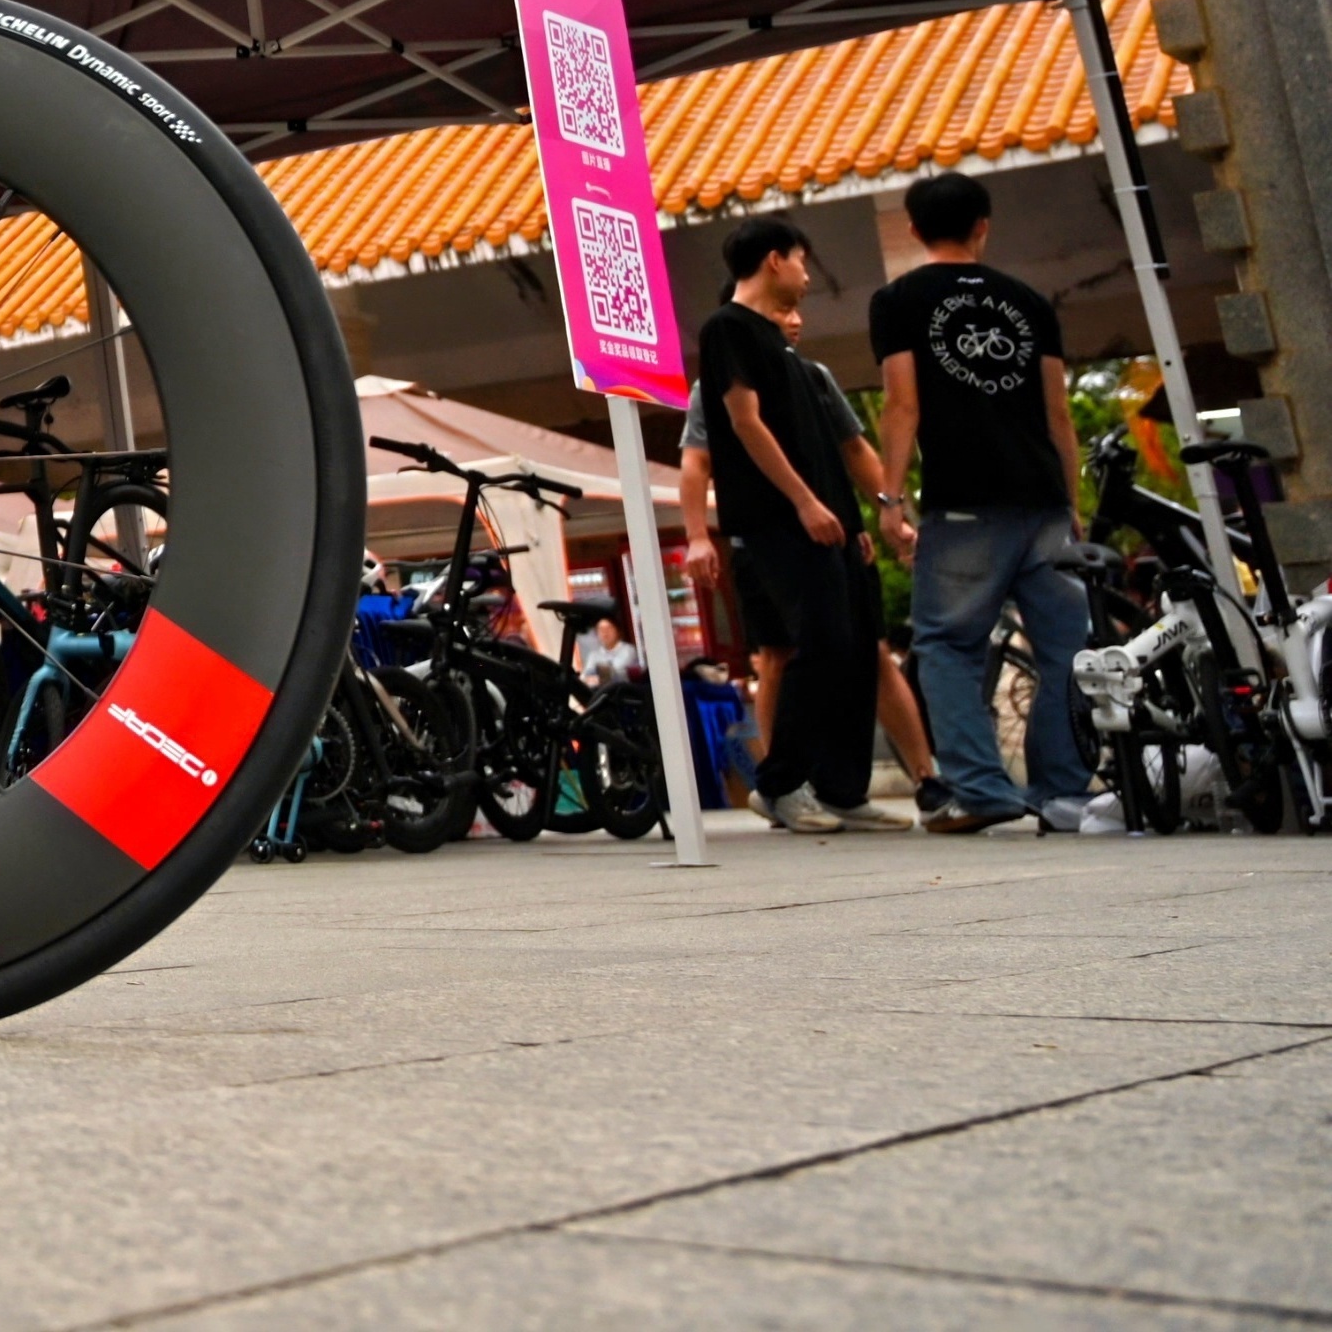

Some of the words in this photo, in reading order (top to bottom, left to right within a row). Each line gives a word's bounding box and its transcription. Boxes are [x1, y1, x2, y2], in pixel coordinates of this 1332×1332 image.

[67, 44, 141, 96] Dynamic
[138, 92, 176, 123] sport
[929, 307, 950, 338] THE
[1017, 341, 1034, 367] WA
[1152, 620, 1189, 652] JAVA
[107, 703, 205, 777] DECAF
